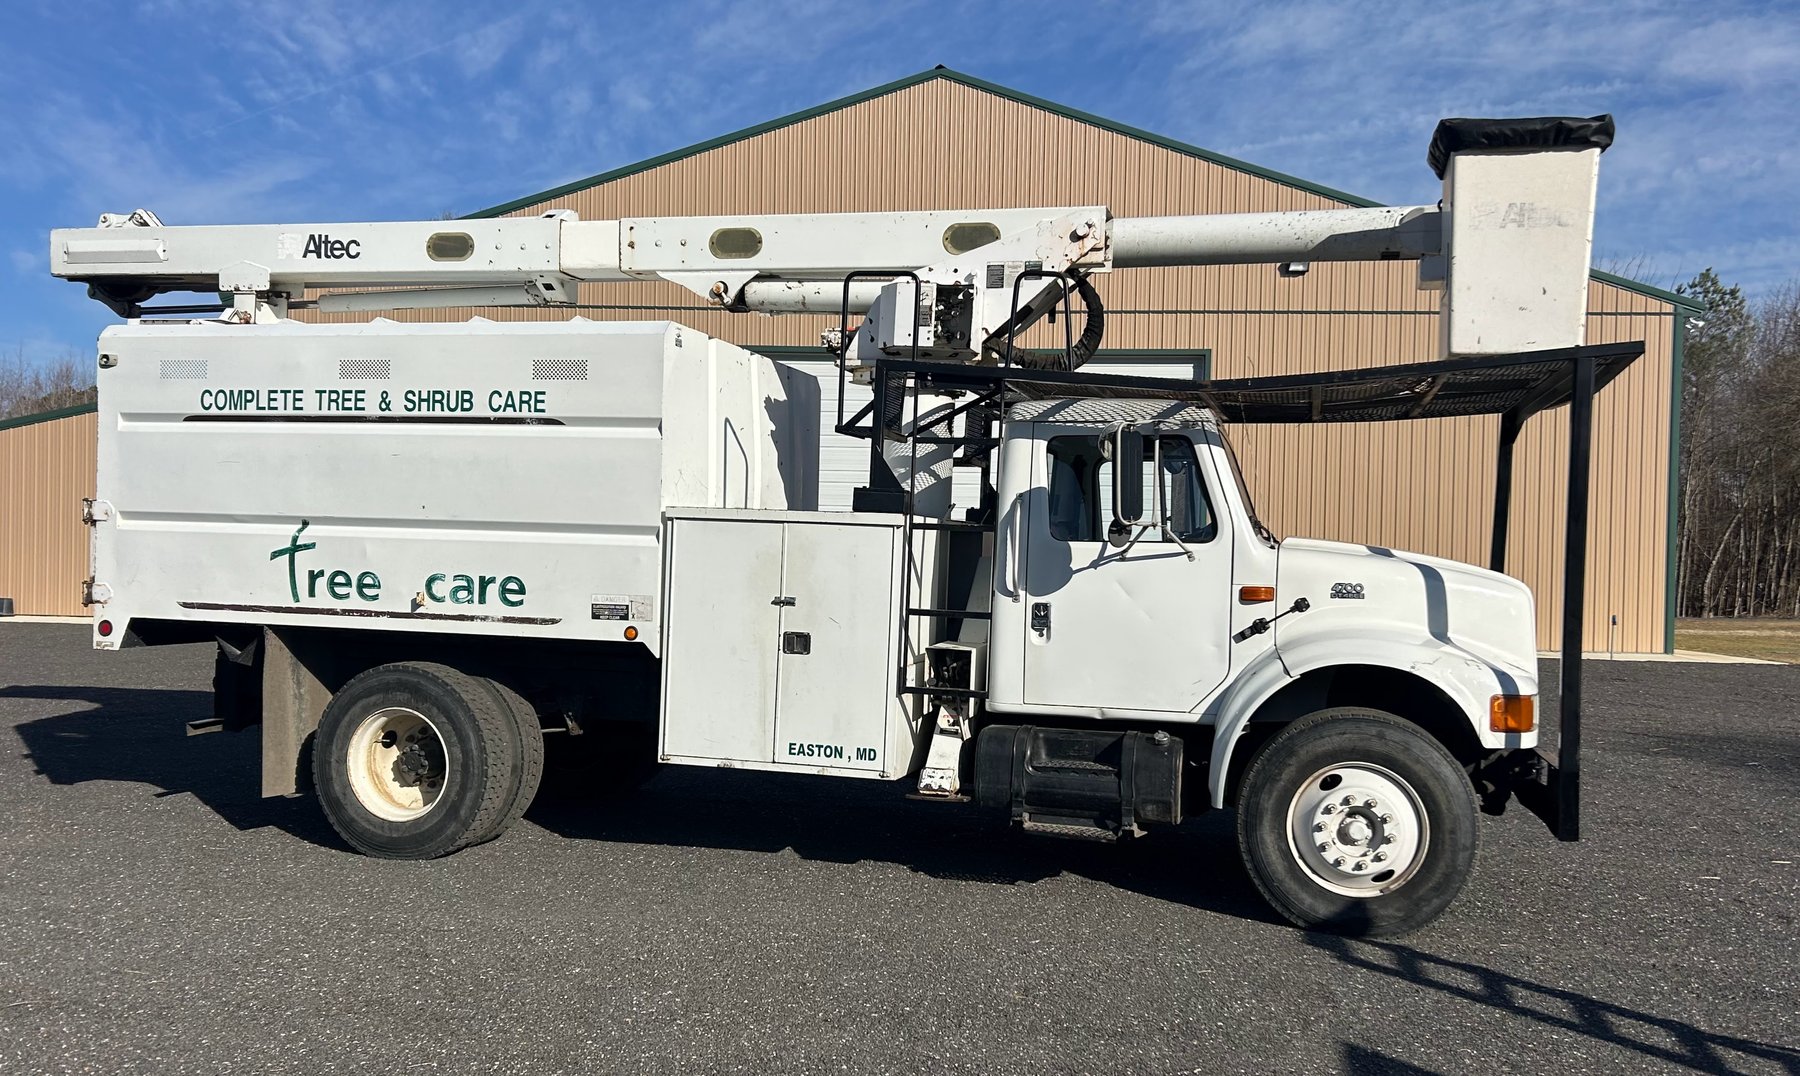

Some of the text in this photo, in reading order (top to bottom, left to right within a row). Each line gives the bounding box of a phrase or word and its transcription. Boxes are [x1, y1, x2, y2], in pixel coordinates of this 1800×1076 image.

[302, 234, 361, 259] Altec
[200, 389, 547, 413] COMPLETE TREE & SHRUB CARE
[424, 573, 527, 607] care
[1330, 582, 1365, 593] 4700
[788, 742, 843, 759] EASTON
[856, 747, 877, 761] MD
